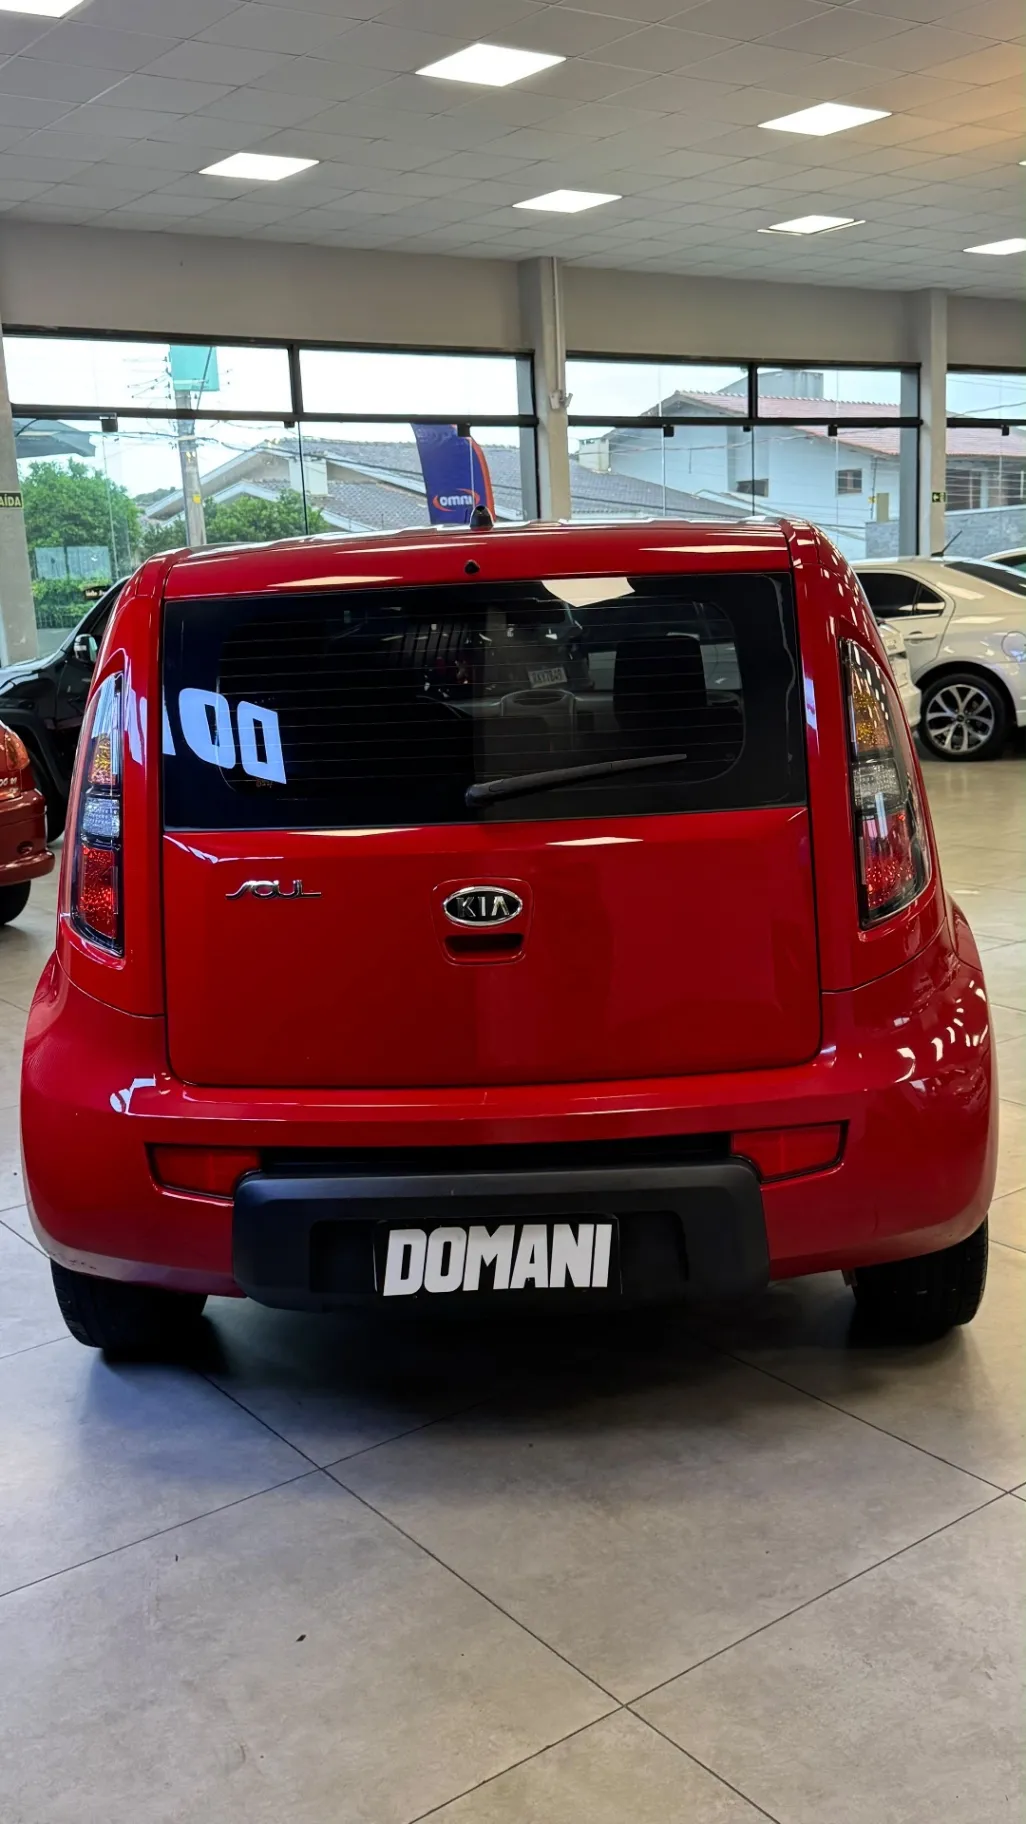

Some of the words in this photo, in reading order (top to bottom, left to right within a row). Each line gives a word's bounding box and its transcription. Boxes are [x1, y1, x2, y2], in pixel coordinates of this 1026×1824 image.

[440, 495, 473, 506] omni
[455, 896, 510, 918] KIA
[383, 1223, 612, 1296] DOMANI
